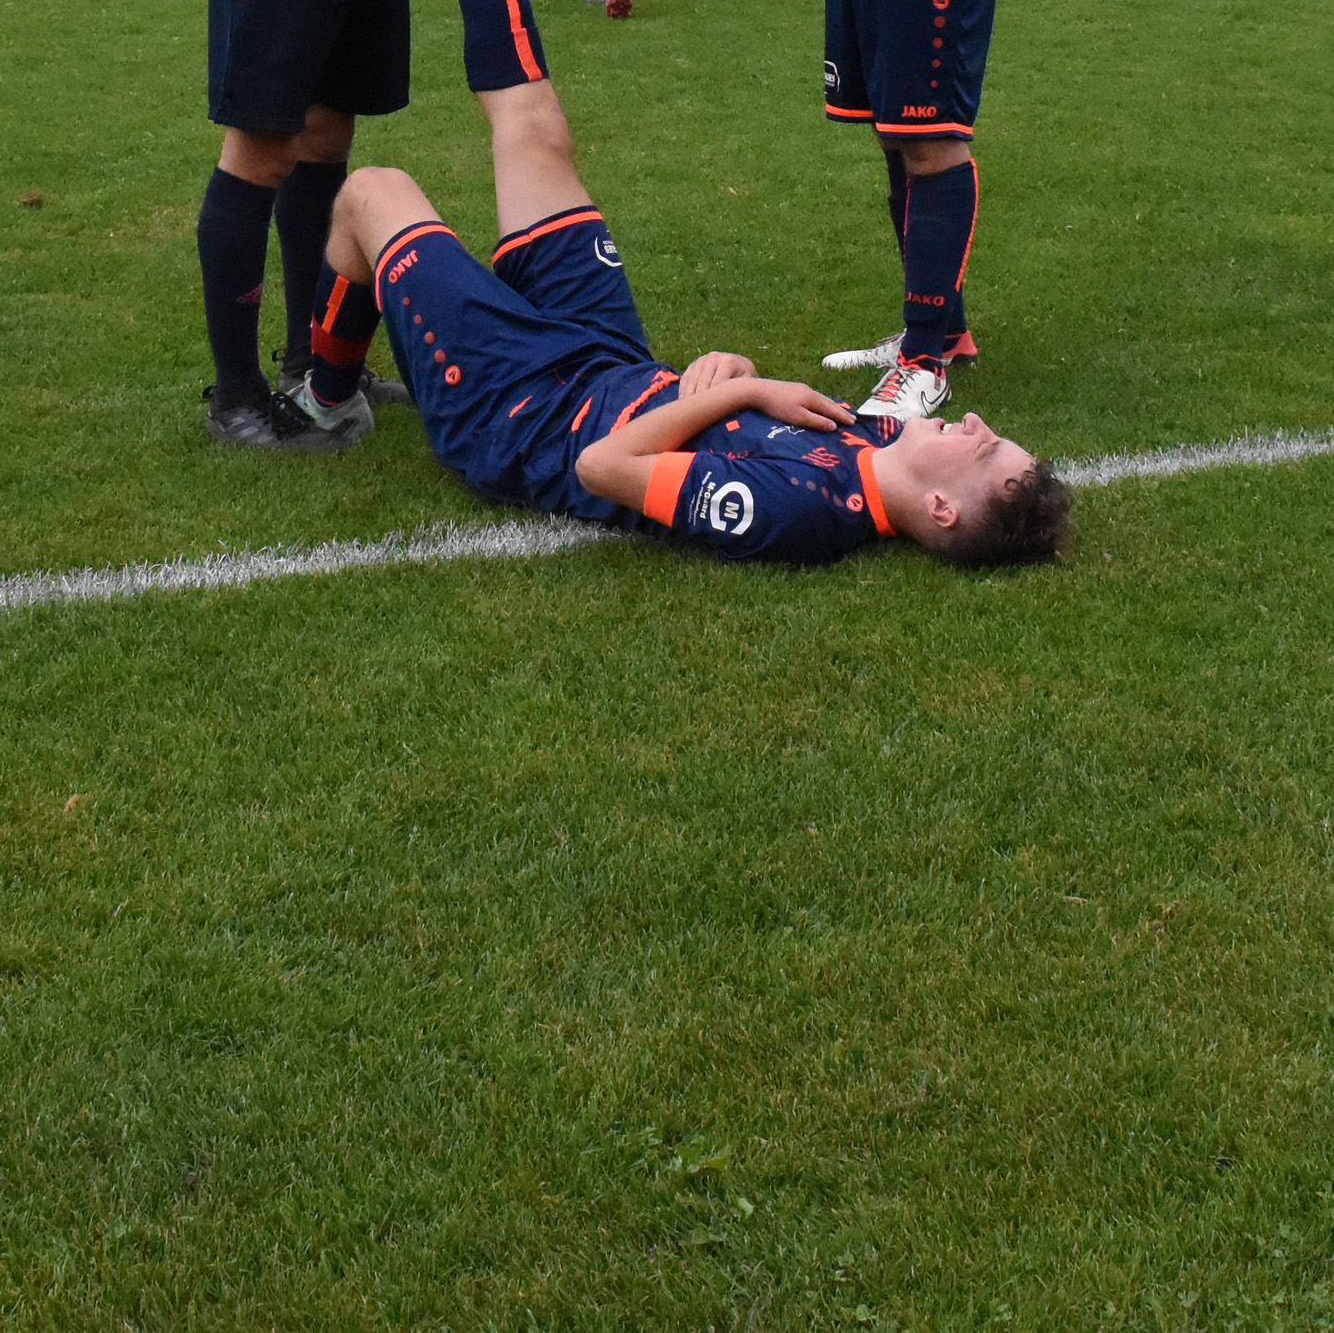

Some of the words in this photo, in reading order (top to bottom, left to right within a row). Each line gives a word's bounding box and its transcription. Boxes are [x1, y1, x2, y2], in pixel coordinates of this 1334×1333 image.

[901, 105, 938, 118] JAKO
[388, 249, 419, 284] JAKO
[905, 291, 945, 307] JAKO
[699, 481, 717, 520] M-Guard
